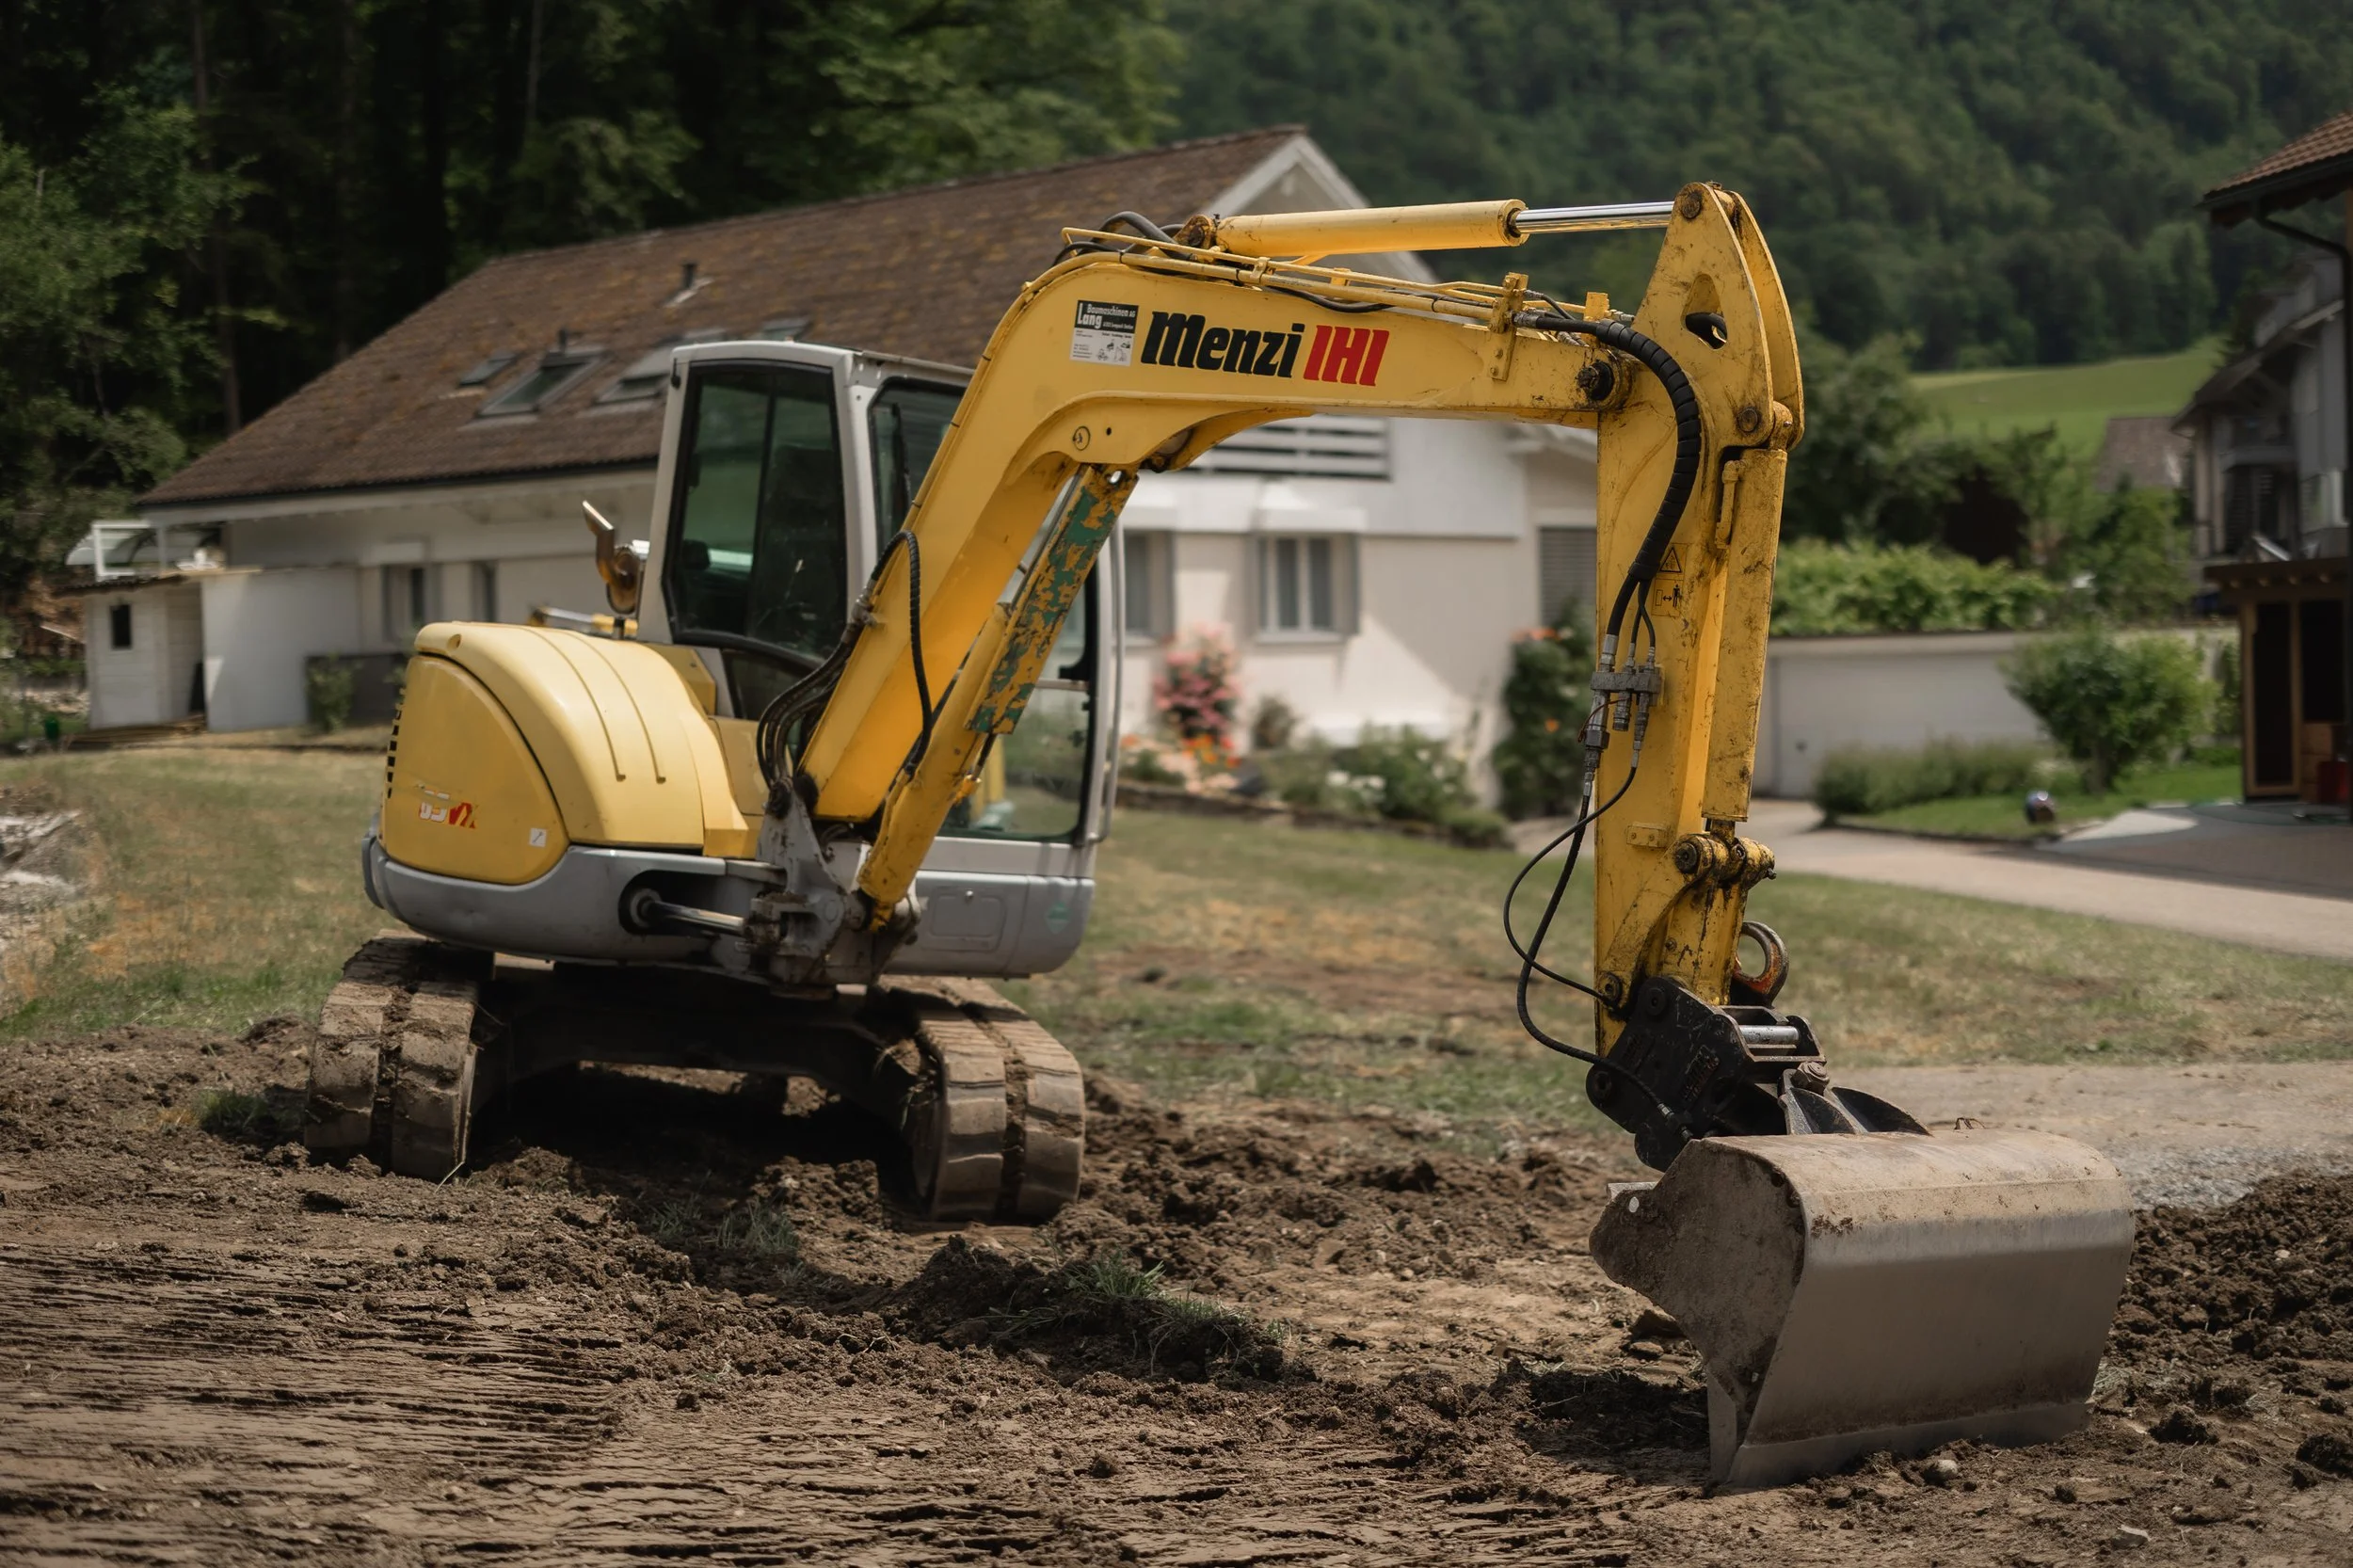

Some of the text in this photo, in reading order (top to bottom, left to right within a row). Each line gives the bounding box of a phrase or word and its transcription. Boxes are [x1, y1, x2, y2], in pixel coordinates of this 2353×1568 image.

[1077, 303, 1102, 328] Lang
[1141, 312, 1389, 386] Menzi IHI
